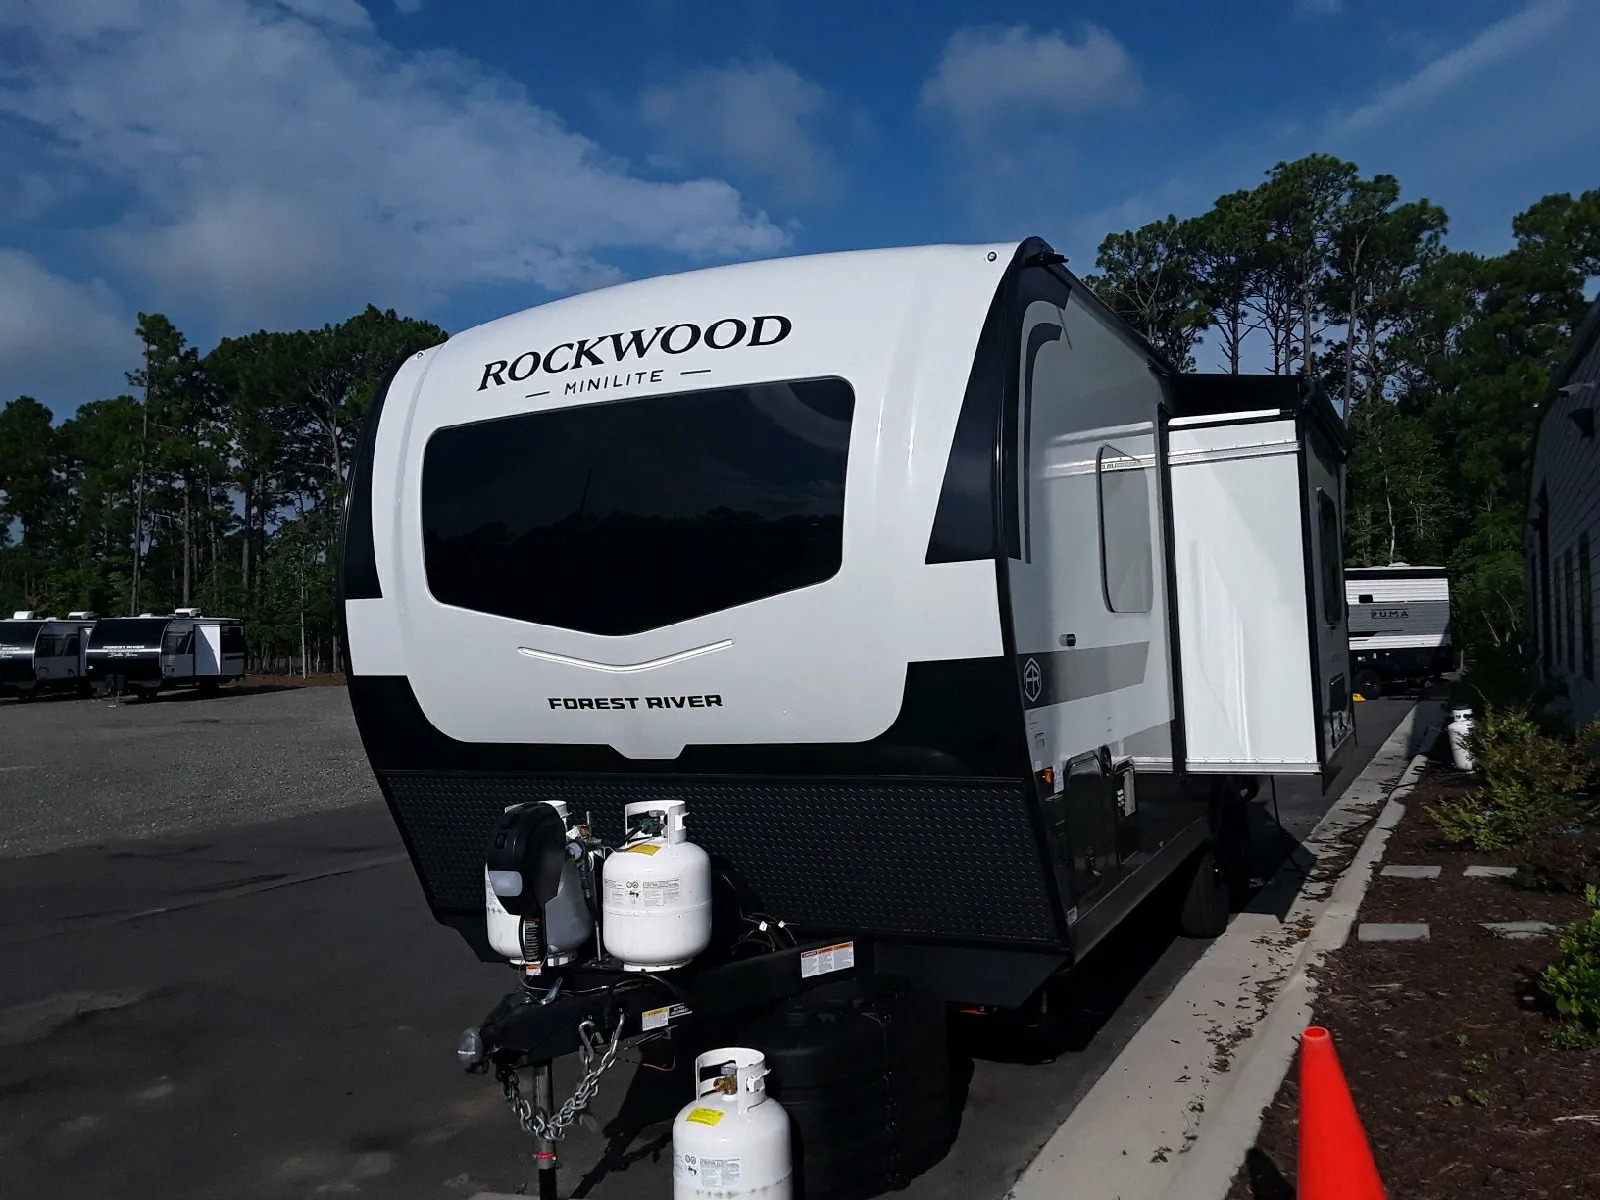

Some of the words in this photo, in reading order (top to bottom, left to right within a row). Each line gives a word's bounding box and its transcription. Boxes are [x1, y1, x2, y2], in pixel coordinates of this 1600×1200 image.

[477, 315, 792, 391] ROCKWOOD
[564, 369, 664, 395] MINILITE
[1371, 610, 1409, 618] PUMA
[547, 697, 640, 710] FOREST
[644, 694, 724, 709] RIVER
